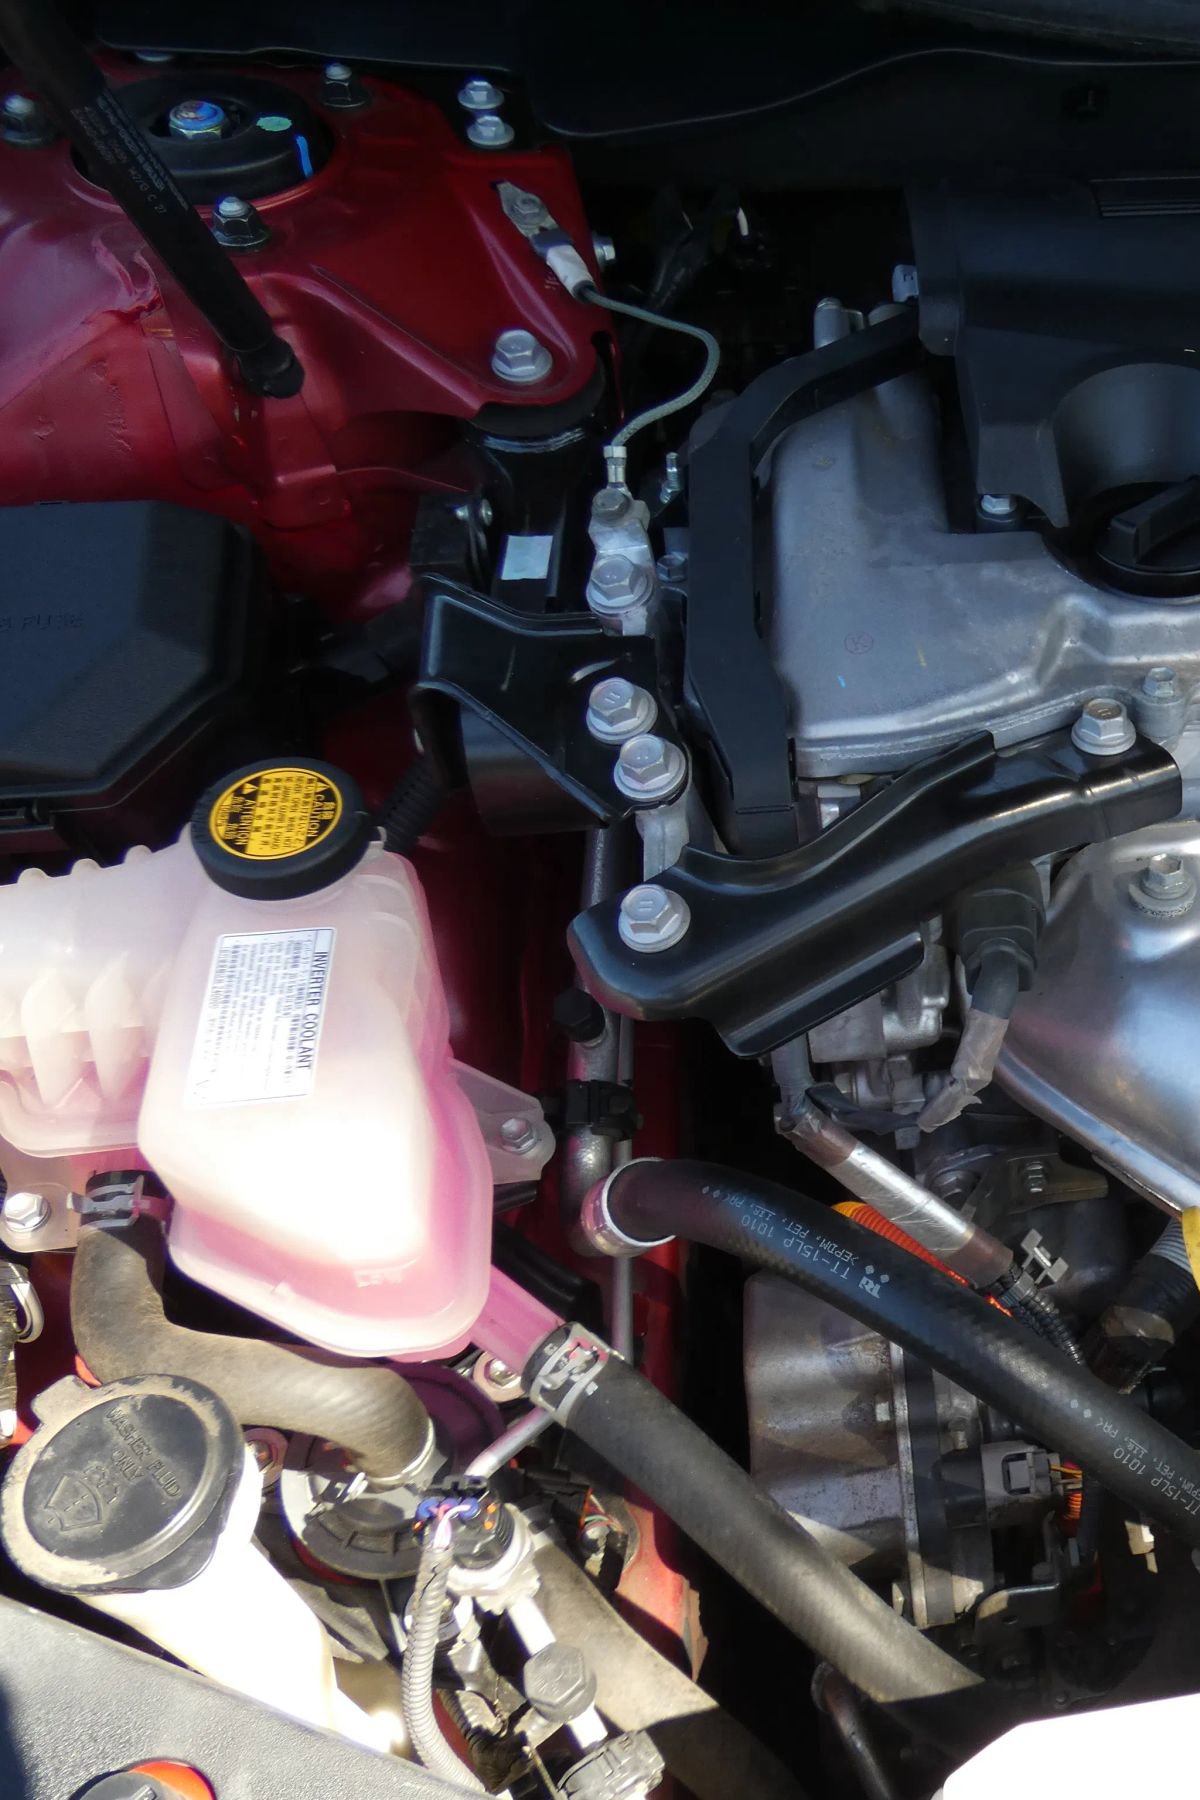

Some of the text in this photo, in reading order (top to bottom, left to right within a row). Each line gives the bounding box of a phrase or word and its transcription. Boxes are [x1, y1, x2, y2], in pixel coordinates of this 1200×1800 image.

[235, 799, 256, 845] ATTENTION
[306, 794, 325, 837] CAUTION
[296, 951, 329, 1069] INVERTER COOLANT
[783, 1237, 850, 1280] TT-15LP
[104, 1407, 181, 1499] WASHER FLUID
[109, 1449, 145, 1482] ONLY
[1150, 1476, 1200, 1515] TT-15LP
